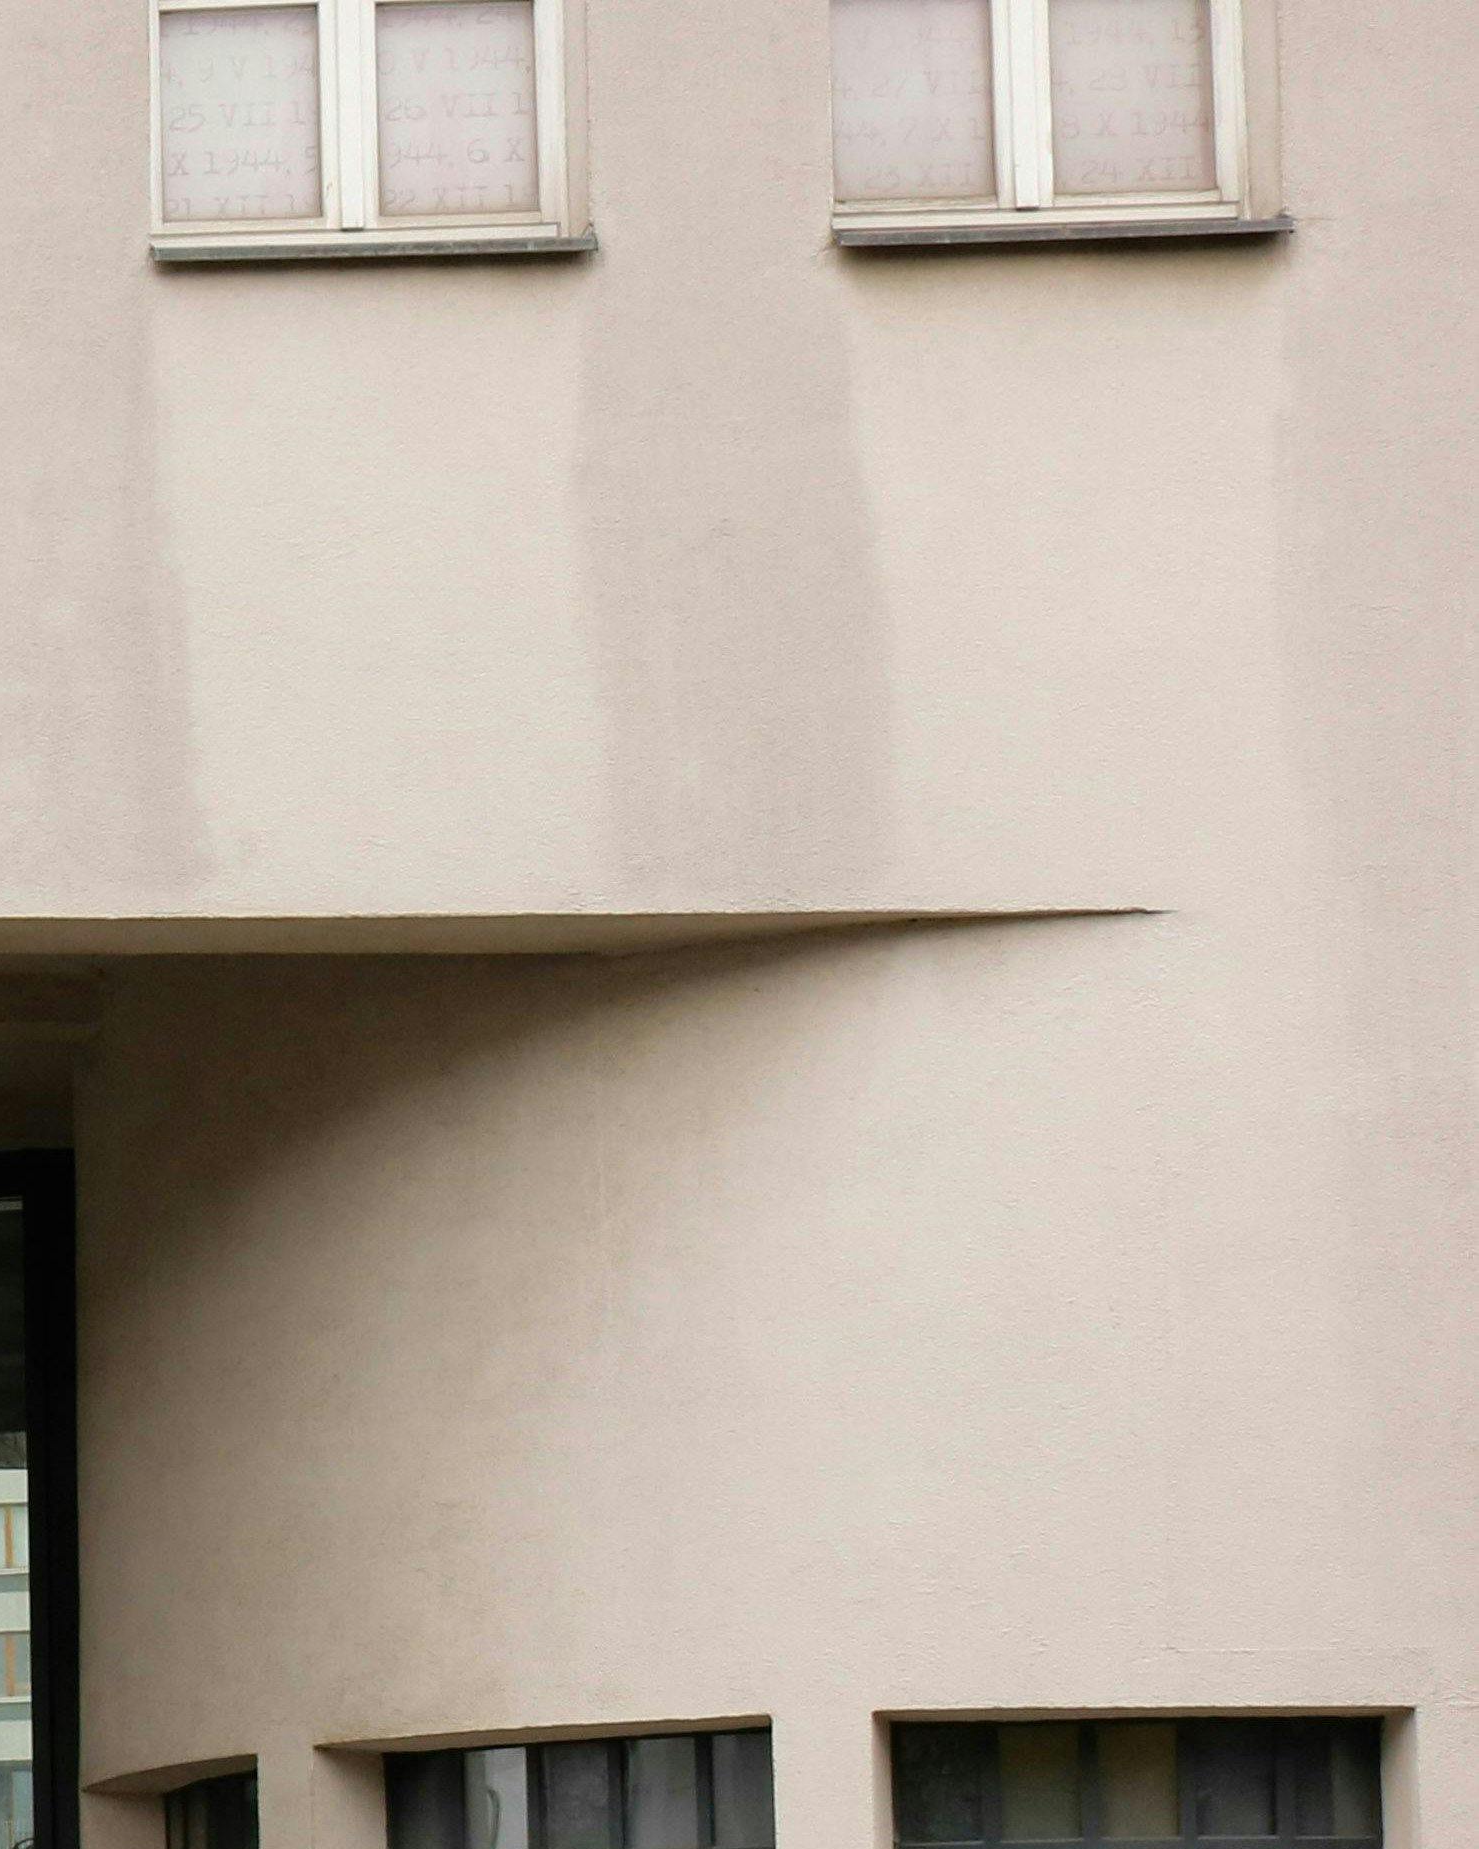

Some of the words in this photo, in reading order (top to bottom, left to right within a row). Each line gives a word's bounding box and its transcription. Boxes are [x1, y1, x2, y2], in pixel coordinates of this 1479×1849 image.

[227, 54, 249, 81] V
[411, 47, 431, 72] V
[870, 72, 910, 99] 27
[1088, 66, 1129, 92] 28
[168, 102, 207, 132] 25
[217, 101, 277, 127] VII
[384, 95, 429, 121] 26
[439, 92, 500, 118] VII
[897, 116, 920, 142] 7
[930, 115, 954, 142] X
[1094, 111, 1119, 137] X
[166, 150, 190, 176] X
[466, 138, 491, 164] 6
[501, 137, 526, 162] X
[1081, 158, 1124, 184] 24
[1134, 156, 1195, 182] XII
